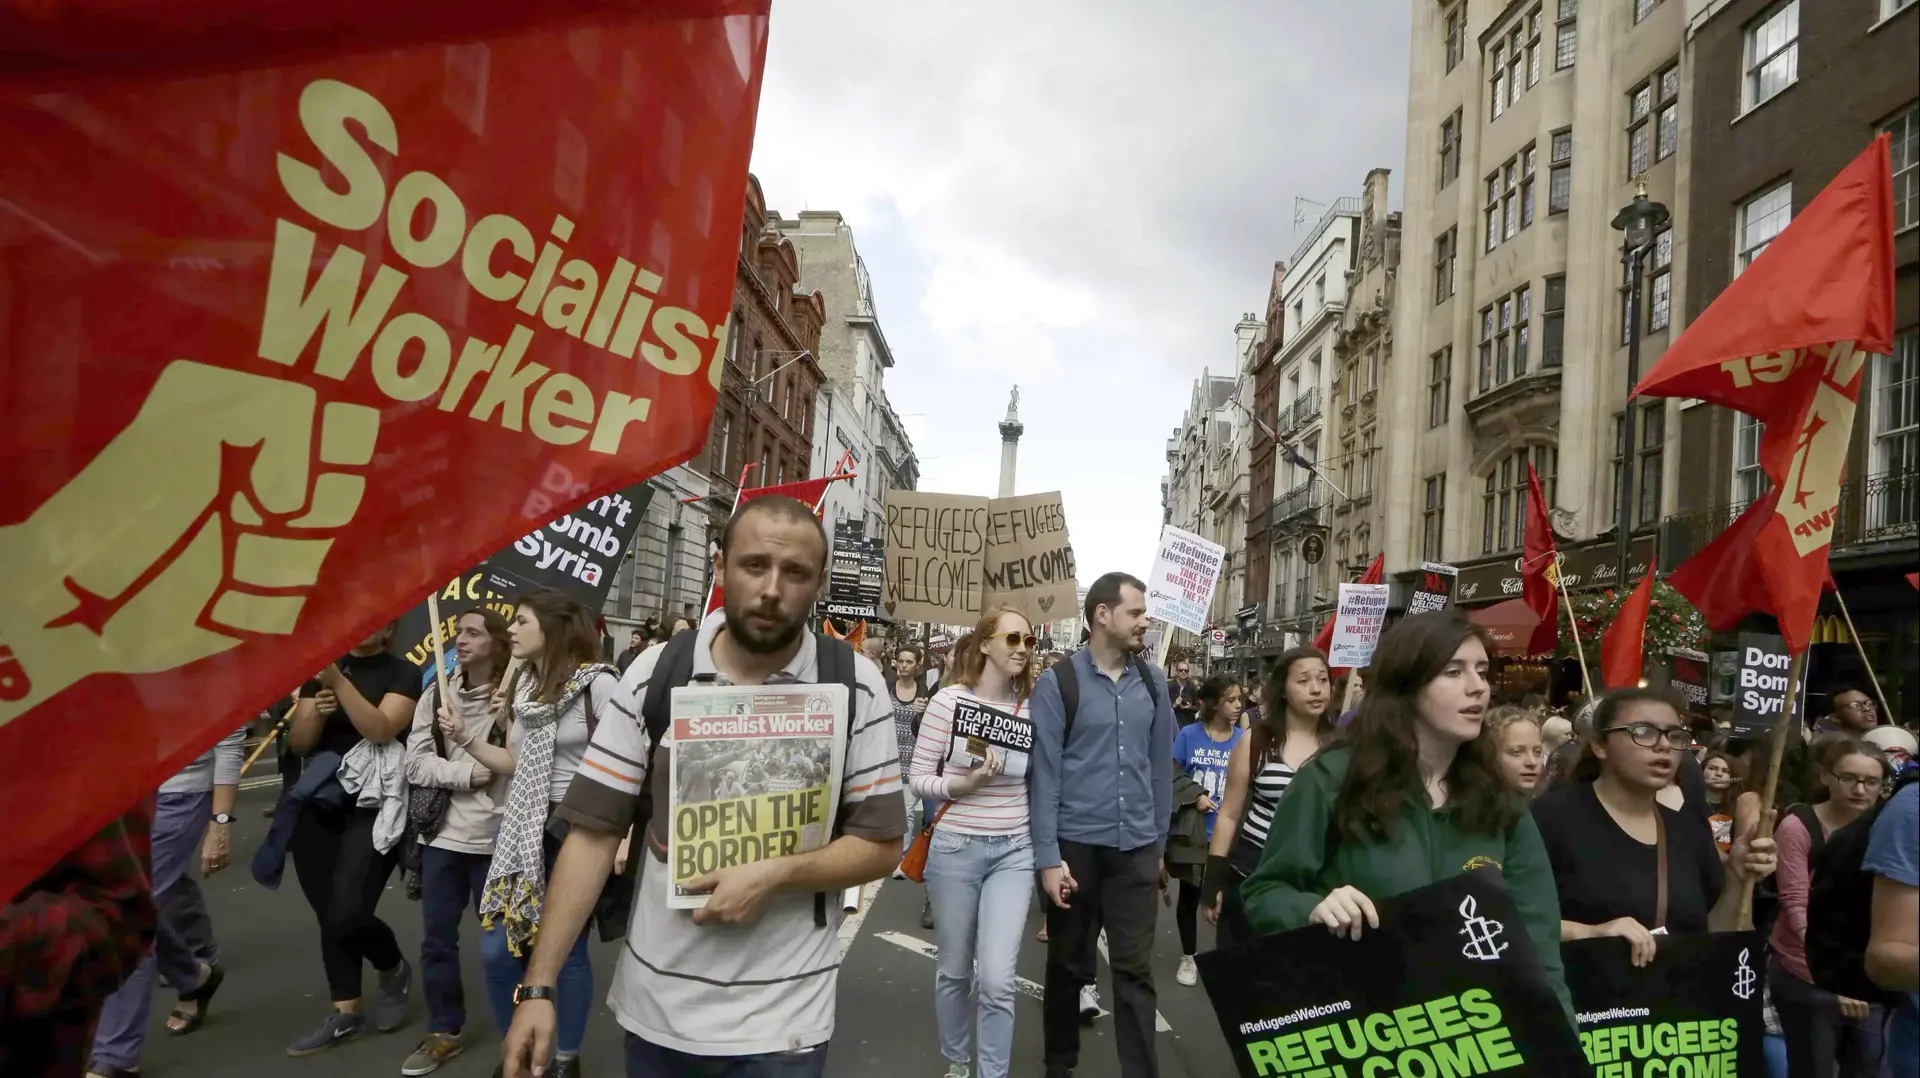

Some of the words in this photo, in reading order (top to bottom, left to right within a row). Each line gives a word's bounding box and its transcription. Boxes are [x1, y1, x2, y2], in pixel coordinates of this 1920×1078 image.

[258, 217, 650, 455] Worker
[886, 504, 986, 561] REFUGEES
[514, 529, 604, 588] Syria
[1161, 547, 1216, 578] LivesMatter
[1171, 540, 1219, 567] #Refugee
[984, 546, 1076, 591] WELCOME
[1180, 567, 1198, 582] TAKE
[1199, 574, 1213, 588] THE
[884, 555, 982, 613] WELCOME
[1166, 573, 1196, 592] WEALTH
[1196, 582, 1211, 597] OFF
[1182, 588, 1196, 602] THE
[1348, 595, 1387, 606] #Refugee
[1411, 598, 1444, 611] WELCOME
[1413, 590, 1448, 604] REFUGEES
[1340, 605, 1385, 616] LivesMatter
[1357, 617, 1373, 626] TAKE
[1373, 616, 1382, 625] THE
[1345, 625, 1372, 634] WEALTH
[1360, 634, 1371, 643] THE
[1671, 679, 1708, 697] REFUGEES
[688, 714, 767, 736] Socialist
[767, 713, 833, 735] Worker
[956, 718, 981, 736] THE
[981, 725, 1033, 749] FENCES
[959, 706, 992, 726] TEAR
[993, 715, 1032, 736] DOWN
[1194, 747, 1206, 757] WE
[676, 799, 757, 842] OPEN
[768, 789, 822, 829] THE
[1239, 998, 1352, 1035] #RefugeesWelcome
[1245, 988, 1503, 1077] REFUGEES
[1579, 1017, 1738, 1055] REFUGEES
